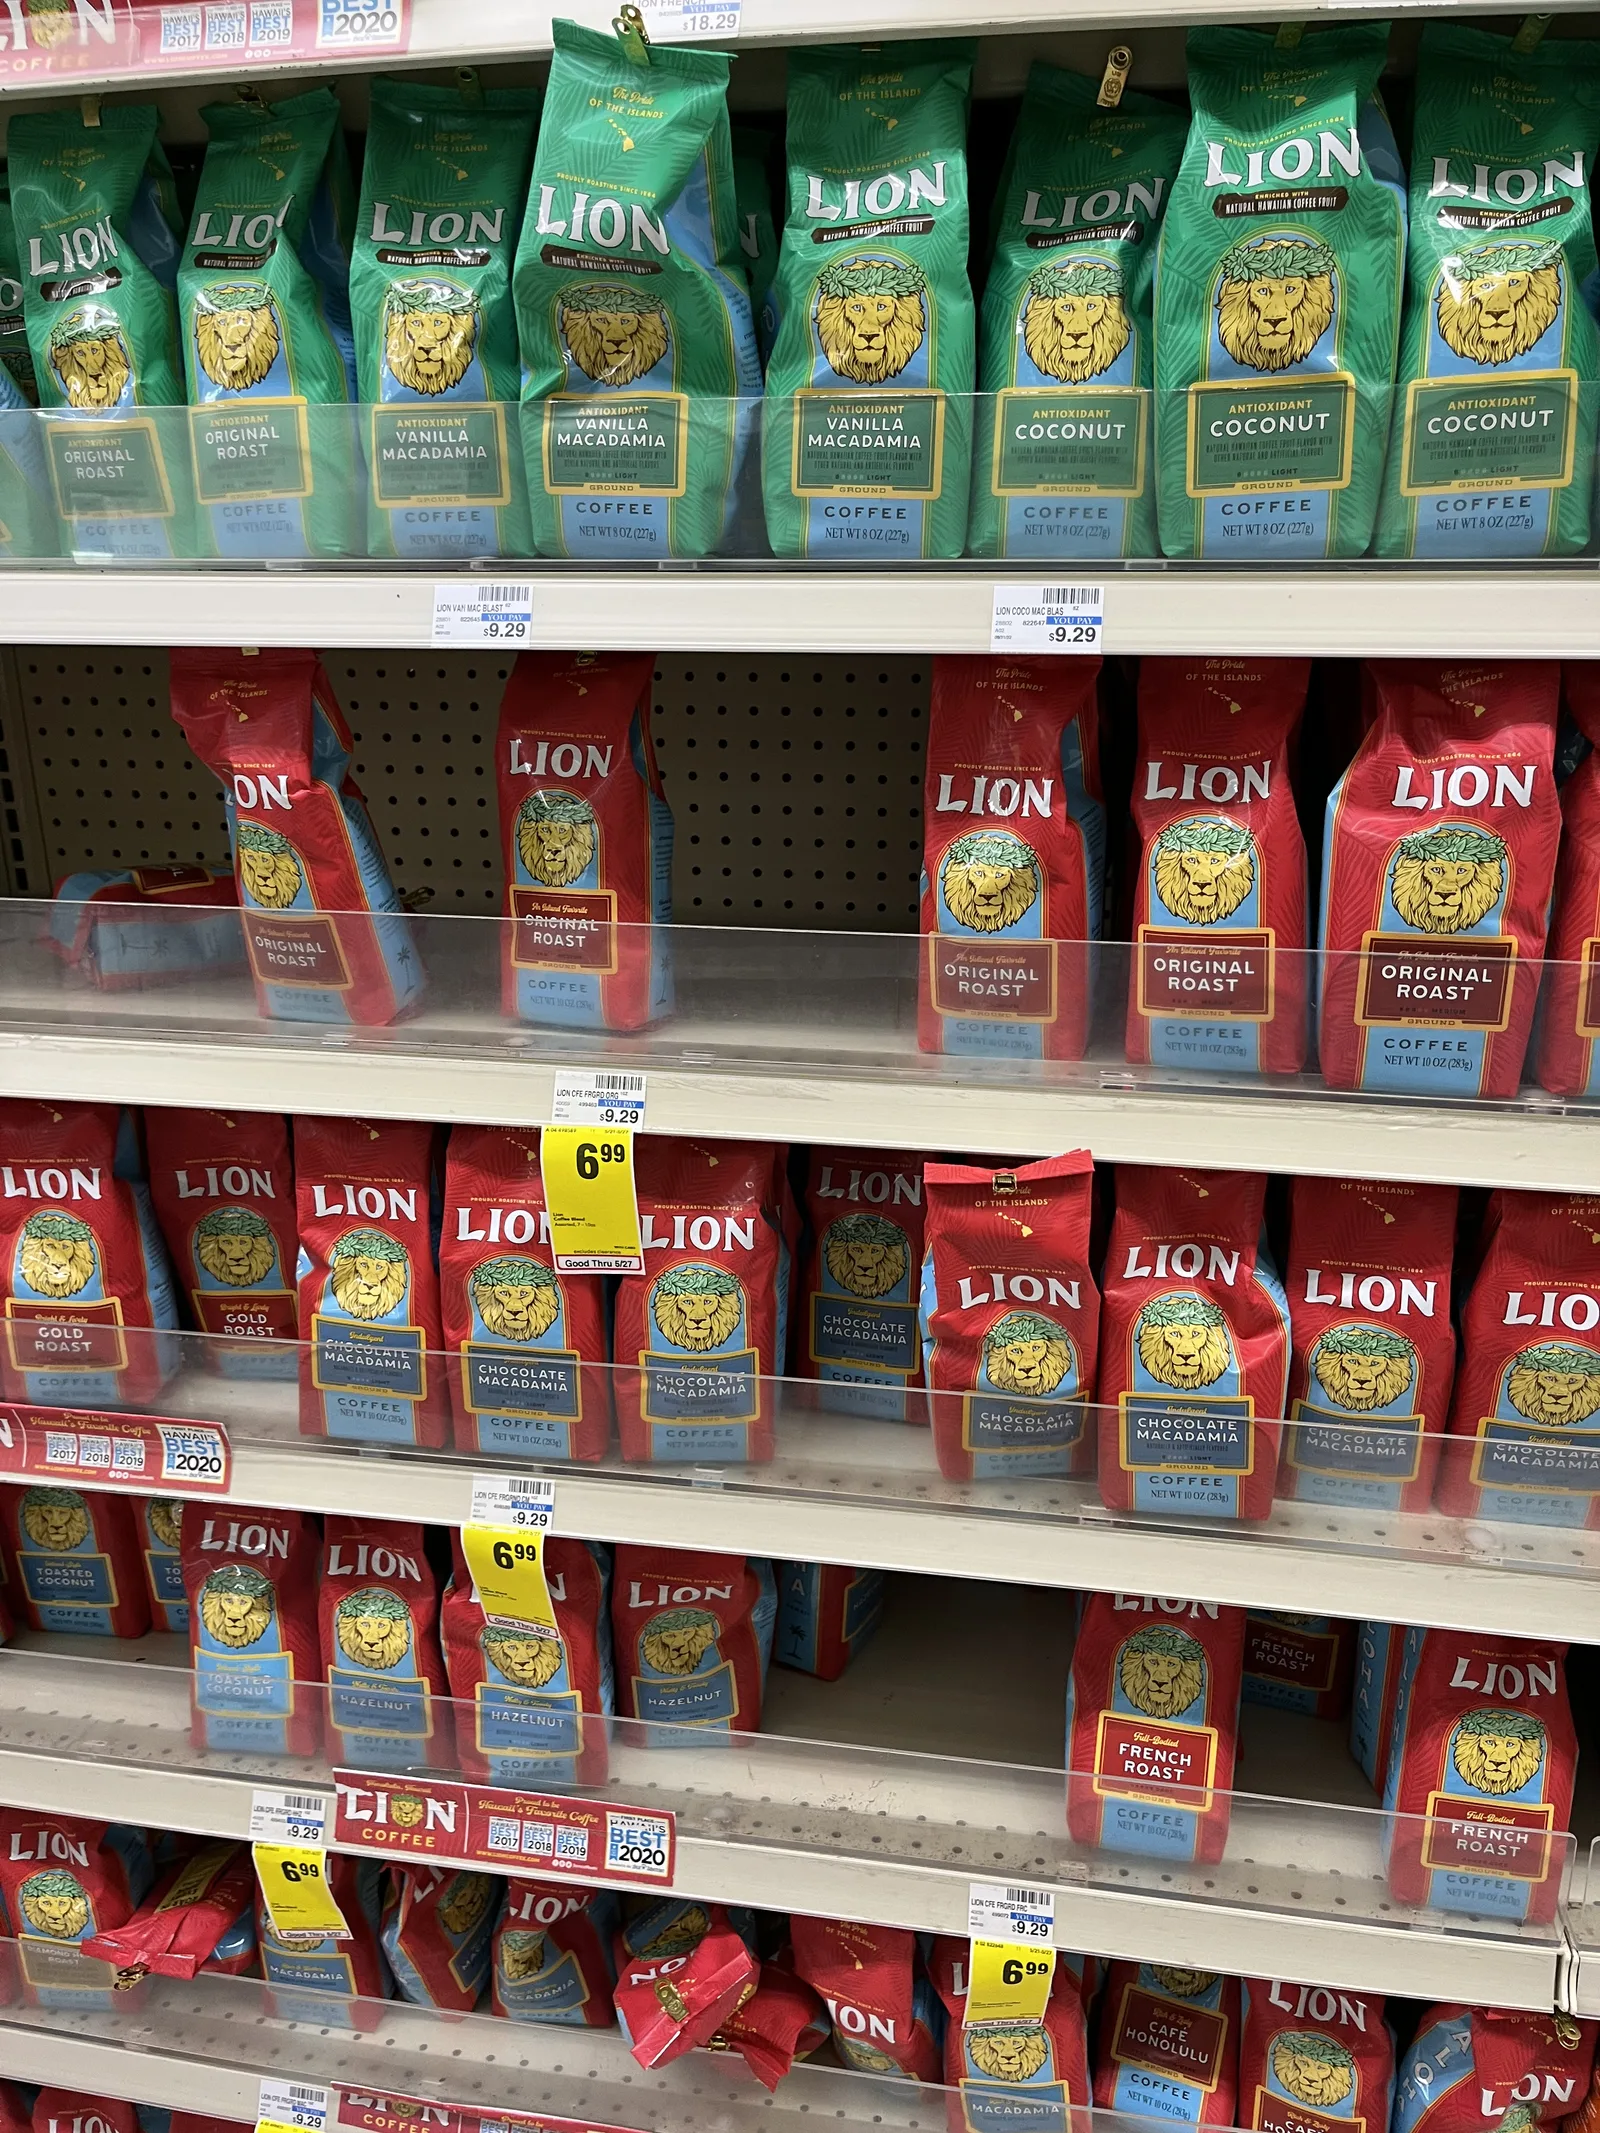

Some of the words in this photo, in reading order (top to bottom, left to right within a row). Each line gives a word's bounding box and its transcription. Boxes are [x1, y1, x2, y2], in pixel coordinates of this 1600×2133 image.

[253, 16, 290, 29] BEST
[334, 12, 398, 35] 2020
[683, 13, 737, 31] $18.29
[168, 35, 200, 47] 2017
[213, 31, 244, 44] 2018
[259, 29, 290, 41] 2019
[589, 97, 604, 108] OF
[606, 101, 624, 114] THE
[627, 106, 665, 119] ISLANDS
[1203, 127, 1362, 188] LION
[557, 172, 585, 185] PROUDLY
[587, 178, 618, 190] ROASTING
[619, 184, 638, 195] SINCE
[1429, 151, 1586, 205] LION
[805, 161, 949, 221] LION
[1255, 191, 1288, 199] ENRICHED
[1020, 177, 1167, 229] LION
[1225, 201, 1256, 214] NATURAL
[1257, 199, 1295, 212] HAWAIIAN
[1296, 197, 1317, 210] COFFEE
[1318, 196, 1337, 208] FRUIT
[369, 201, 505, 246] LION
[535, 184, 670, 256] LION
[28, 214, 118, 277] LION
[577, 405, 649, 417] ANTIOXIDANT
[1228, 399, 1313, 414] ANTIOXIDANT
[576, 418, 649, 431] VANILLA
[826, 416, 904, 433] VANILLA
[1014, 422, 1126, 441] COCONUT
[1210, 413, 1331, 438] COCONUT
[1426, 409, 1554, 436] COCONUT
[204, 427, 280, 444] ORIGINAL
[395, 429, 469, 444] VANILLA
[556, 432, 667, 448] MACADAMIA
[807, 433, 921, 449] MACADAMIA
[63, 448, 136, 464] ORIGINAL
[217, 444, 269, 459] ROAST
[382, 445, 488, 461] MACADAMIA
[75, 465, 126, 479] ROAST
[576, 501, 653, 516] COFFEE
[1221, 499, 1312, 516] COFFEE
[436, 604, 452, 613] LION
[453, 604, 466, 613] VAN
[467, 604, 481, 613] MAC
[482, 604, 504, 613] BLAST
[995, 607, 1011, 616] LION
[1011, 607, 1030, 616] COCO
[1031, 607, 1046, 616] MAC
[1047, 607, 1064, 616] BLAS
[483, 622, 526, 638] $9.29
[1053, 617, 1075, 625] YOU
[1076, 617, 1094, 625] PAY
[1048, 626, 1096, 643] $9.29
[508, 739, 614, 778] LION
[1144, 760, 1272, 804] LION
[1391, 765, 1538, 811] LION
[935, 773, 1056, 819] LION
[524, 914, 599, 933] ORIGINAL
[255, 935, 327, 954] ORIGINAL
[533, 932, 586, 949] ROAST
[267, 952, 317, 968] ROAST
[1153, 957, 1256, 975] ORIGINAL
[944, 963, 1040, 983] ORIGINAL
[1381, 964, 1493, 984] ORIGINAL
[958, 981, 1025, 998] ROAST
[1167, 976, 1239, 993] ROAST
[1396, 984, 1475, 1001] ROAST
[1383, 1037, 1468, 1052] COFFEE
[1384, 1055, 1403, 1067] NET
[1404, 1055, 1421, 1067] WT
[1422, 1056, 1432, 1068] 10
[1433, 1057, 1446, 1068] OZ
[1447, 1058, 1474, 1072] (283g)
[556, 1089, 571, 1098] LION
[572, 1090, 584, 1099] CFE
[599, 1109, 640, 1124] $9.29
[1, 1166, 102, 1200] LION
[175, 1165, 276, 1199] LION
[815, 1166, 922, 1207] LION
[311, 1184, 417, 1222] LION
[641, 1214, 756, 1252] LION
[565, 1259, 590, 1268] Good
[592, 1260, 613, 1269] Thru
[615, 1260, 633, 1269] 5/27
[1122, 1243, 1241, 1287] LION
[956, 1272, 1082, 1311] LION
[1304, 1268, 1437, 1318] LION
[225, 1313, 268, 1325] GOLD
[823, 1313, 906, 1334] CHOCOLATE
[38, 1327, 83, 1339] GOLD
[223, 1325, 275, 1337] ROAST
[822, 1325, 907, 1346] MACADAMIA
[34, 1339, 92, 1353] ROAST
[324, 1352, 412, 1371] MACADAMIA
[477, 1363, 567, 1382] CHOCOLATE
[477, 1376, 568, 1393] MACADAMIA
[1137, 1416, 1238, 1431] CHOCOLATE
[1136, 1429, 1239, 1444] MACADAMIA
[53, 1450, 77, 1459] 2017
[166, 1438, 220, 1456] BEST
[86, 1453, 110, 1463] 2018
[119, 1456, 144, 1466] 2019
[175, 1454, 222, 1473] 2020
[1149, 1475, 1223, 1488] COFFEE
[512, 1511, 548, 1527] $9.29
[200, 1520, 290, 1560] LION
[36, 1567, 93, 1578] TOASTED
[327, 1544, 423, 1583] LION
[36, 1576, 96, 1587] COCONUT
[628, 1581, 733, 1609] LION
[1450, 1655, 1558, 1700] LION
[340, 1694, 413, 1712] HAZELNUT
[648, 1689, 722, 1707] HAZELNUT
[490, 1710, 565, 1729] HAZELNUT
[1133, 1731, 1179, 1748] Full-Bodied
[1118, 1742, 1192, 1767] FRENCH
[1123, 1760, 1185, 1782] ROAST
[1116, 1807, 1184, 1827] COFFEE
[287, 1825, 319, 1840] $9.29
[361, 1828, 436, 1848] COFFEE
[494, 1836, 518, 1847] 2017
[610, 1827, 666, 1849] BEST
[1451, 1823, 1529, 1845] FRENCH
[9, 1831, 90, 1868] LION
[527, 1840, 552, 1851] 2018
[562, 1844, 586, 1856] 2019
[1456, 1838, 1522, 1858] ROAST
[618, 1844, 666, 1866] 2020
[971, 1898, 984, 1907] LION
[985, 1900, 996, 1909] CFE
[1012, 1920, 1049, 1937] $9.29
[270, 1965, 344, 1982] MACADAMIA
[1268, 1980, 1368, 2033] LION
[1148, 2020, 1188, 2043] CAFÉ
[1125, 2026, 1209, 2065] HONOLULU
[1130, 2072, 1191, 2101] COFFEE
[972, 2103, 1060, 2115] MACADAMIA
